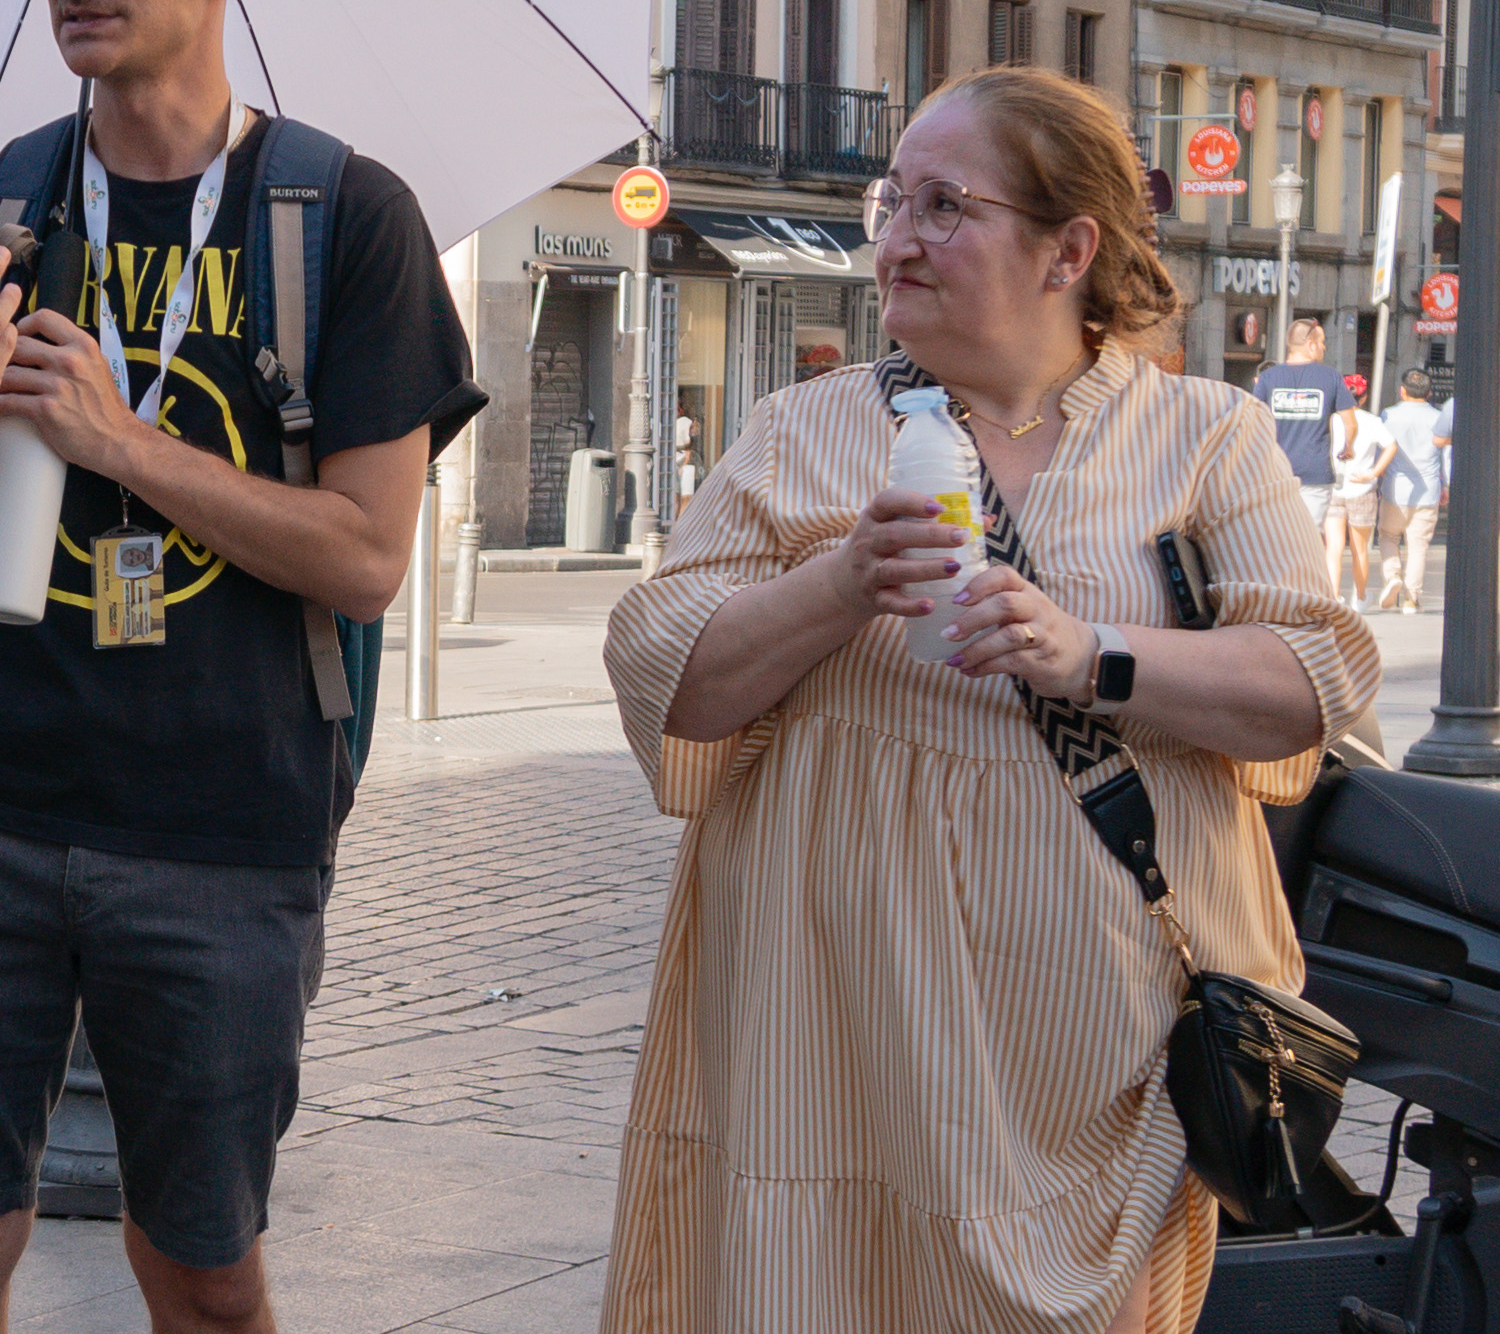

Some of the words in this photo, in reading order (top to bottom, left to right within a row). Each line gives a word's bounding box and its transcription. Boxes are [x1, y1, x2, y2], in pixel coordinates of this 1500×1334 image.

[269, 188, 319, 198] BURTON
[535, 224, 564, 256] las
[566, 232, 613, 259] muns
